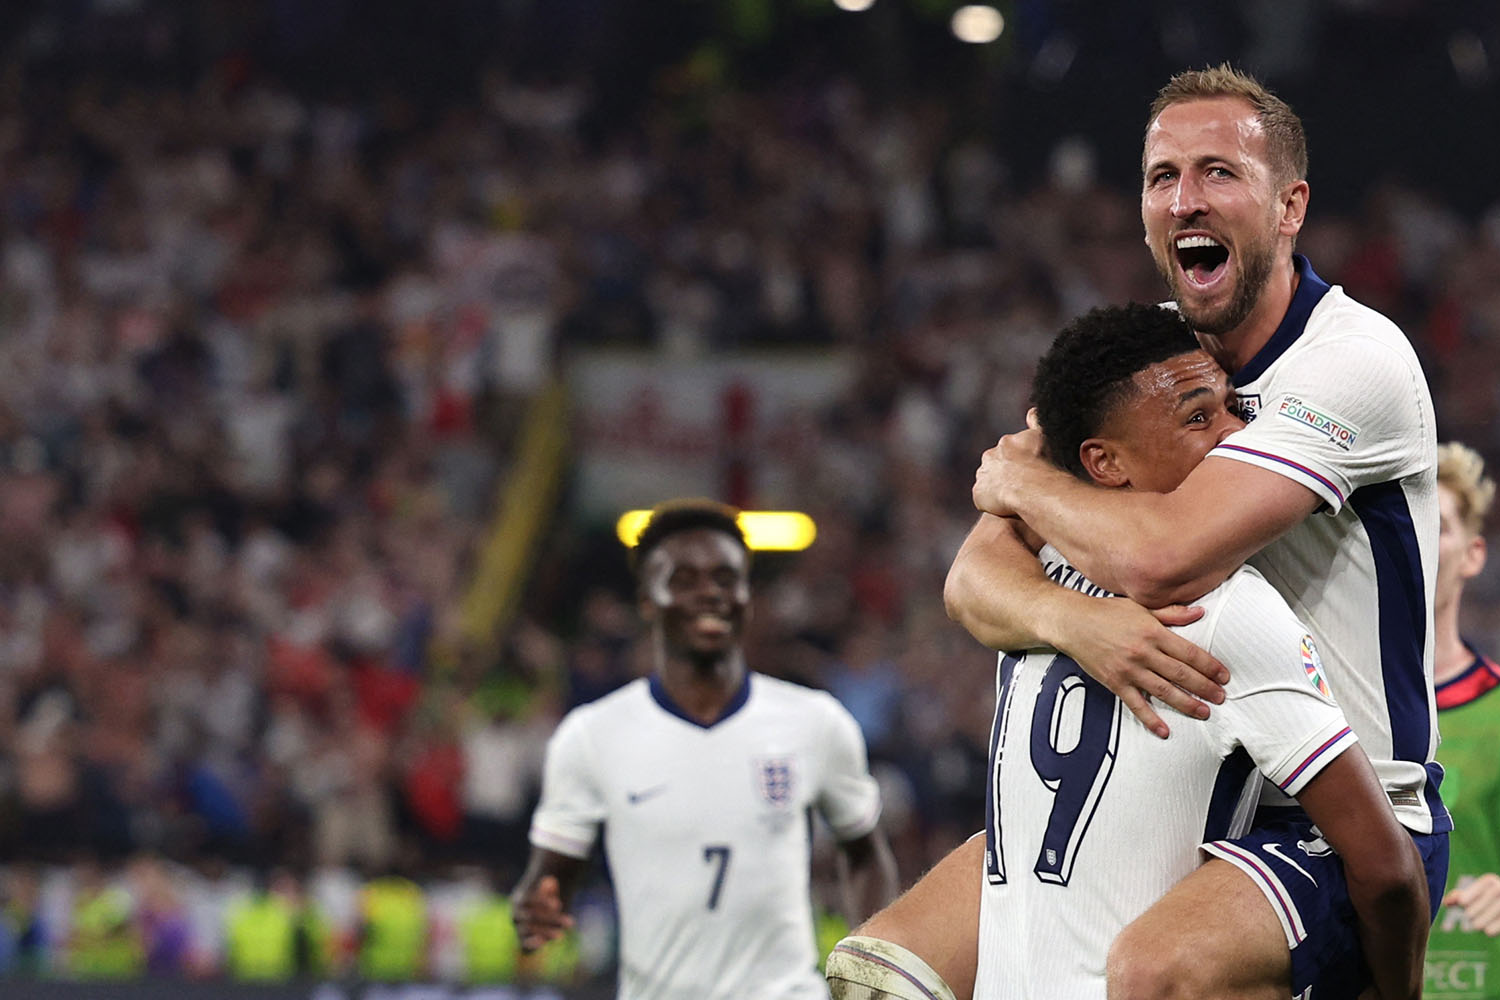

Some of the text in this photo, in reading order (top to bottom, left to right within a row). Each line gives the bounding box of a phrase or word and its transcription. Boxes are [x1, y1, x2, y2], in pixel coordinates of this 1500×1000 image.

[1279, 402, 1356, 446] FOUNDATION
[985, 651, 1122, 888] 19
[704, 846, 731, 910] 7
